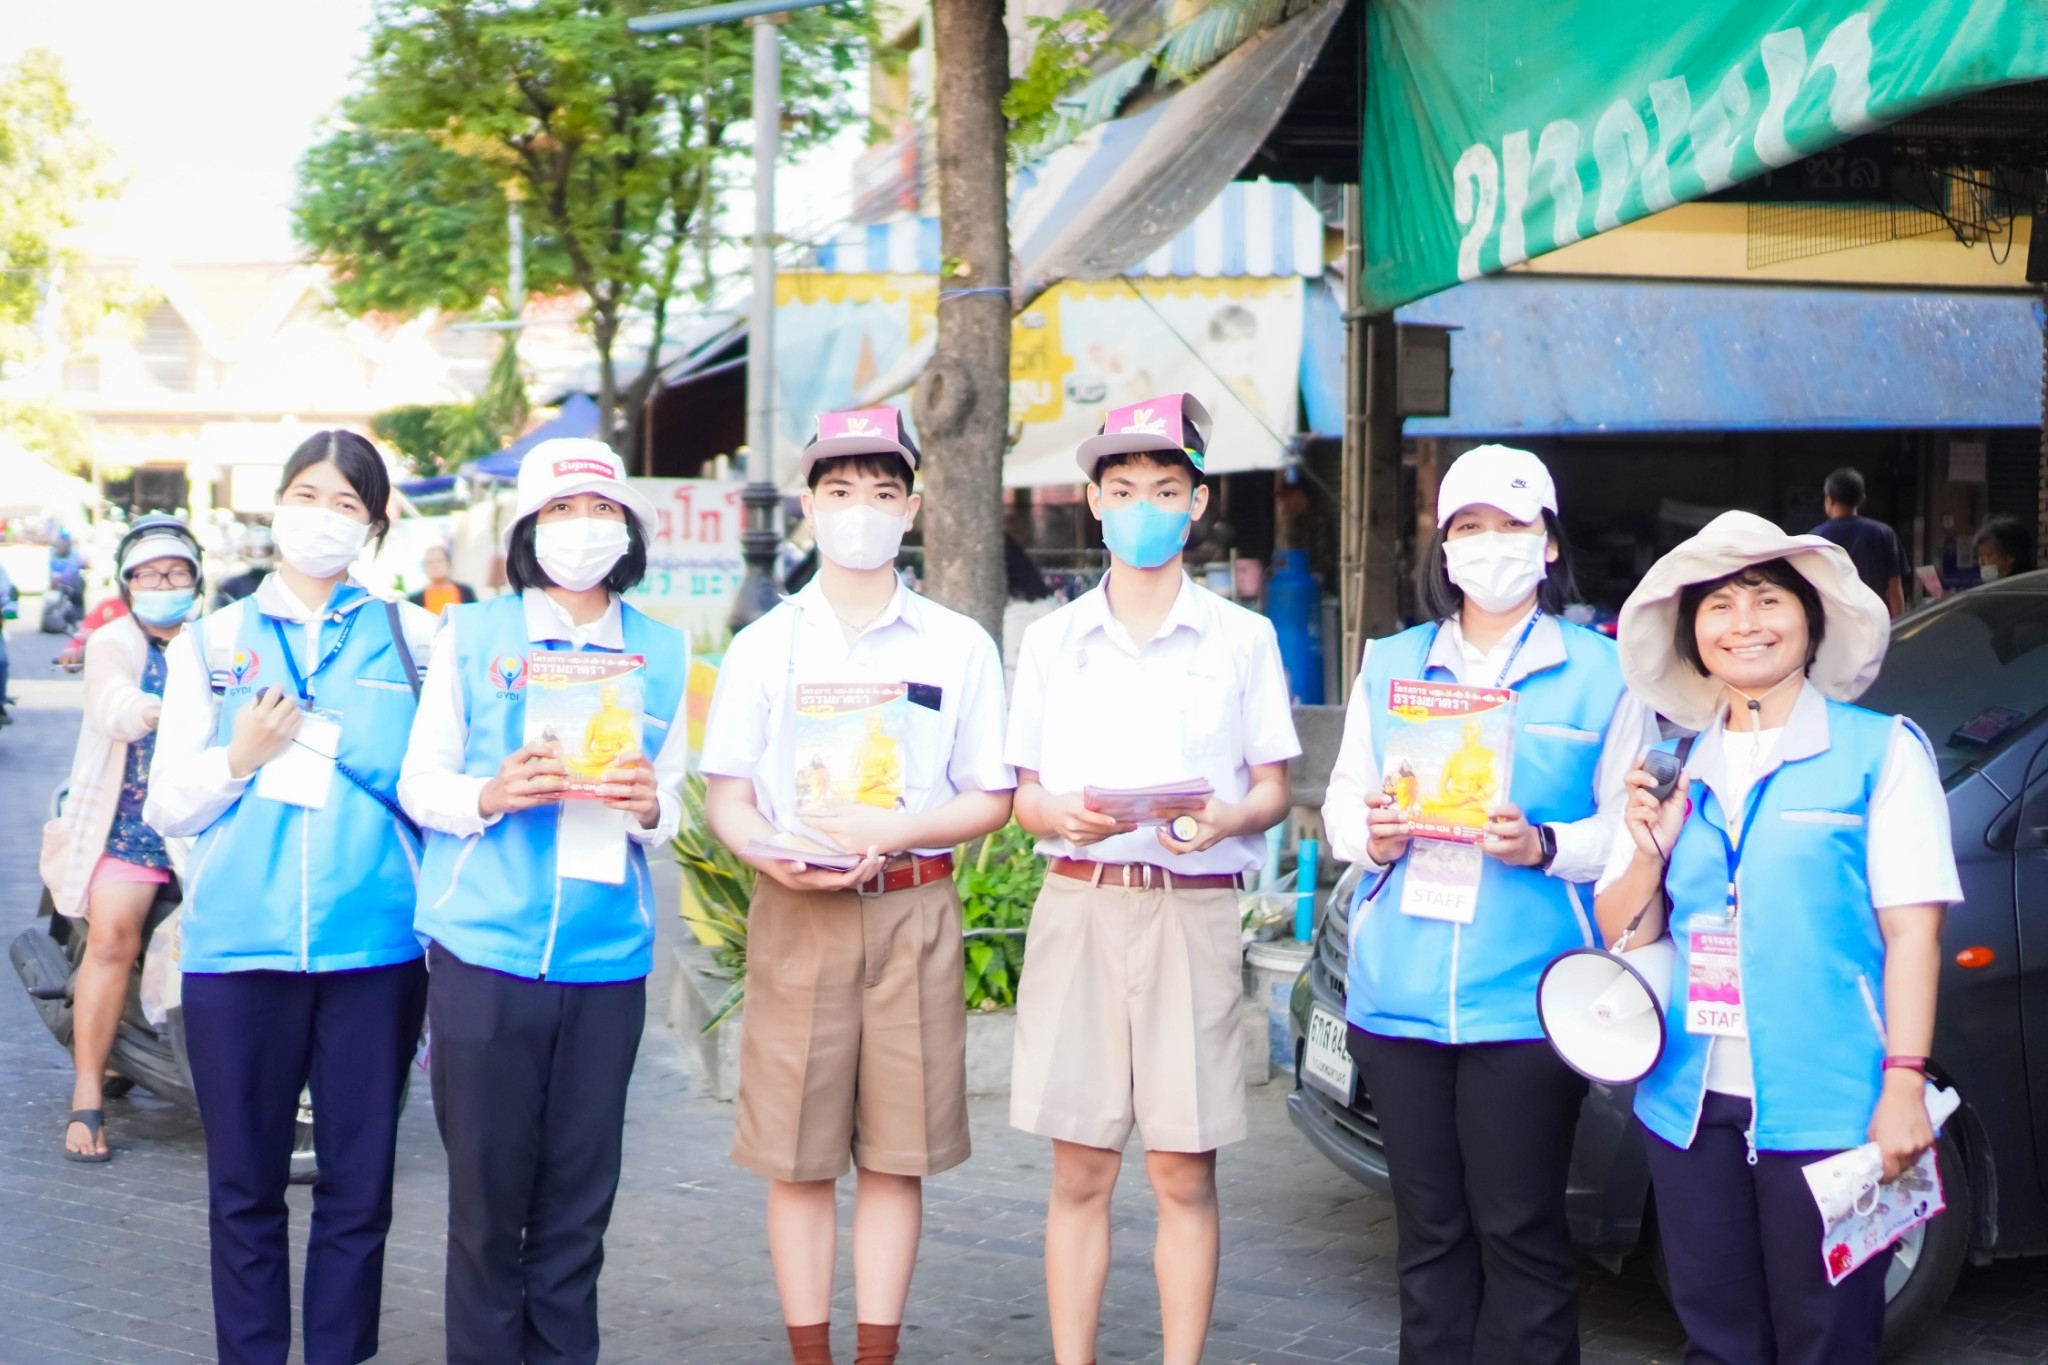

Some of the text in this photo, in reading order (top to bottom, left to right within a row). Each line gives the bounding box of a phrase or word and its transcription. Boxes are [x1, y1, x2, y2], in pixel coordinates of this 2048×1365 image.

[559, 461, 614, 475] Supreme
[532, 653, 565, 663] โครงการ
[533, 663, 605, 675] ธรรมยาตรา
[230, 686, 251, 696] GYDI
[1393, 682, 1427, 695] โครงการ
[496, 691, 519, 701] GYDI
[801, 695, 870, 705] ธรรมยาตรา
[1393, 693, 1469, 711] ธรรมยาตรา
[1414, 888, 1466, 909] STAFF
